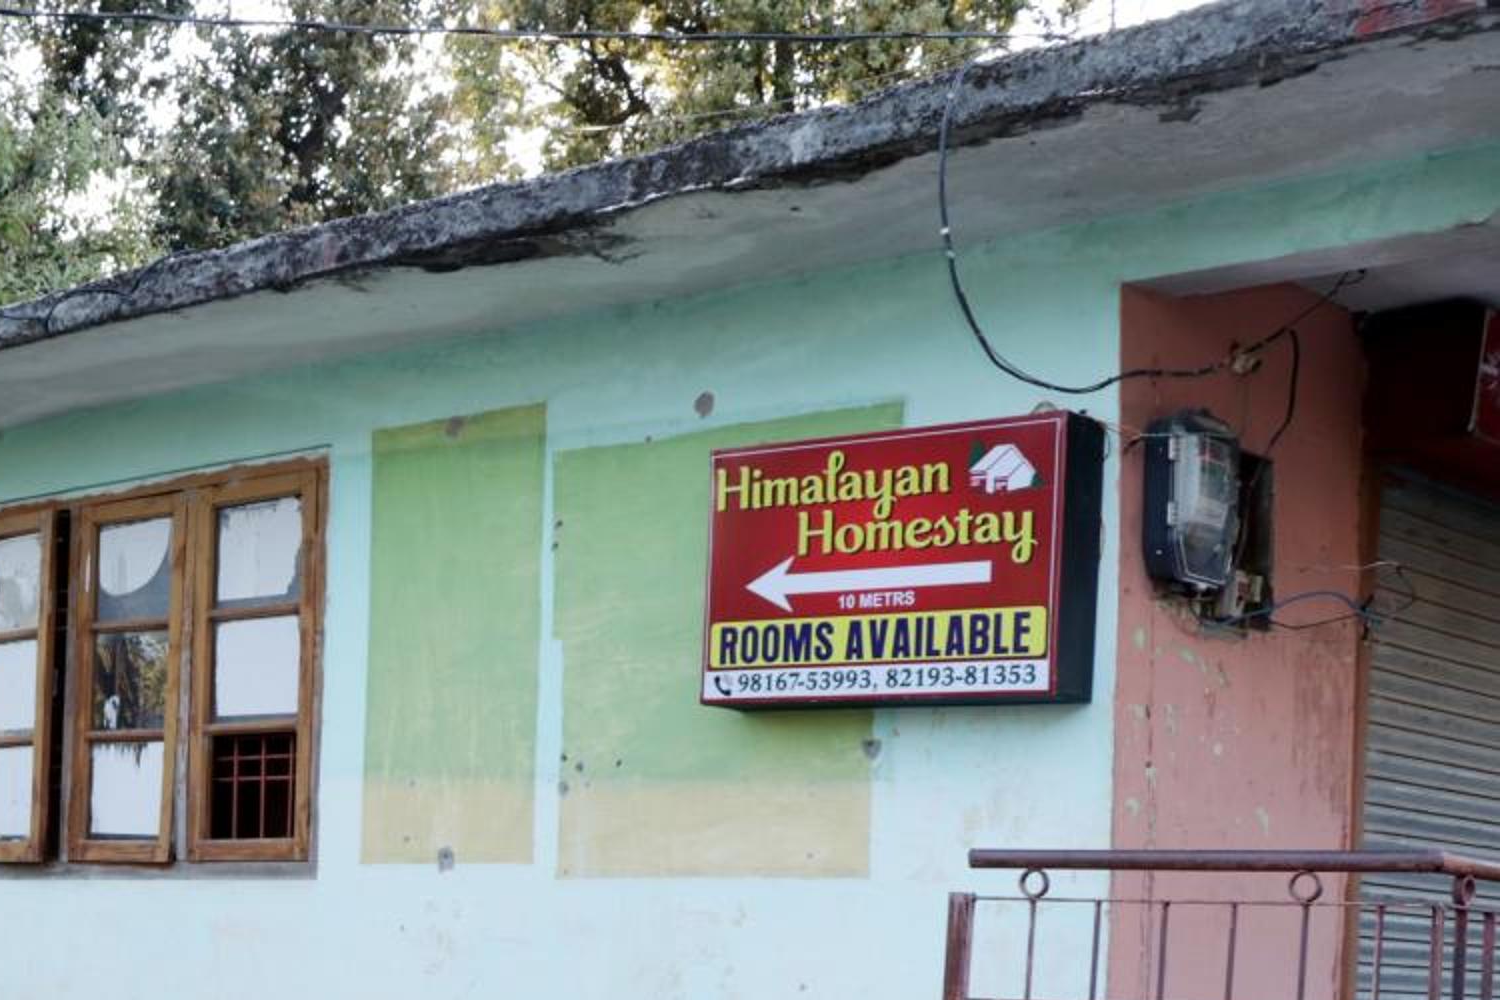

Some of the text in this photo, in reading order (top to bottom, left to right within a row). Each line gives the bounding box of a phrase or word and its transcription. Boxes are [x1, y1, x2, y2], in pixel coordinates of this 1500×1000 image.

[716, 450, 951, 519] Himalayan
[797, 508, 1038, 565] Homestay
[837, 590, 916, 610] 10 METRS
[719, 611, 1031, 664] ROOMS AVAILABLE
[737, 664, 1036, 693] 98167-53993, 82193-81353
